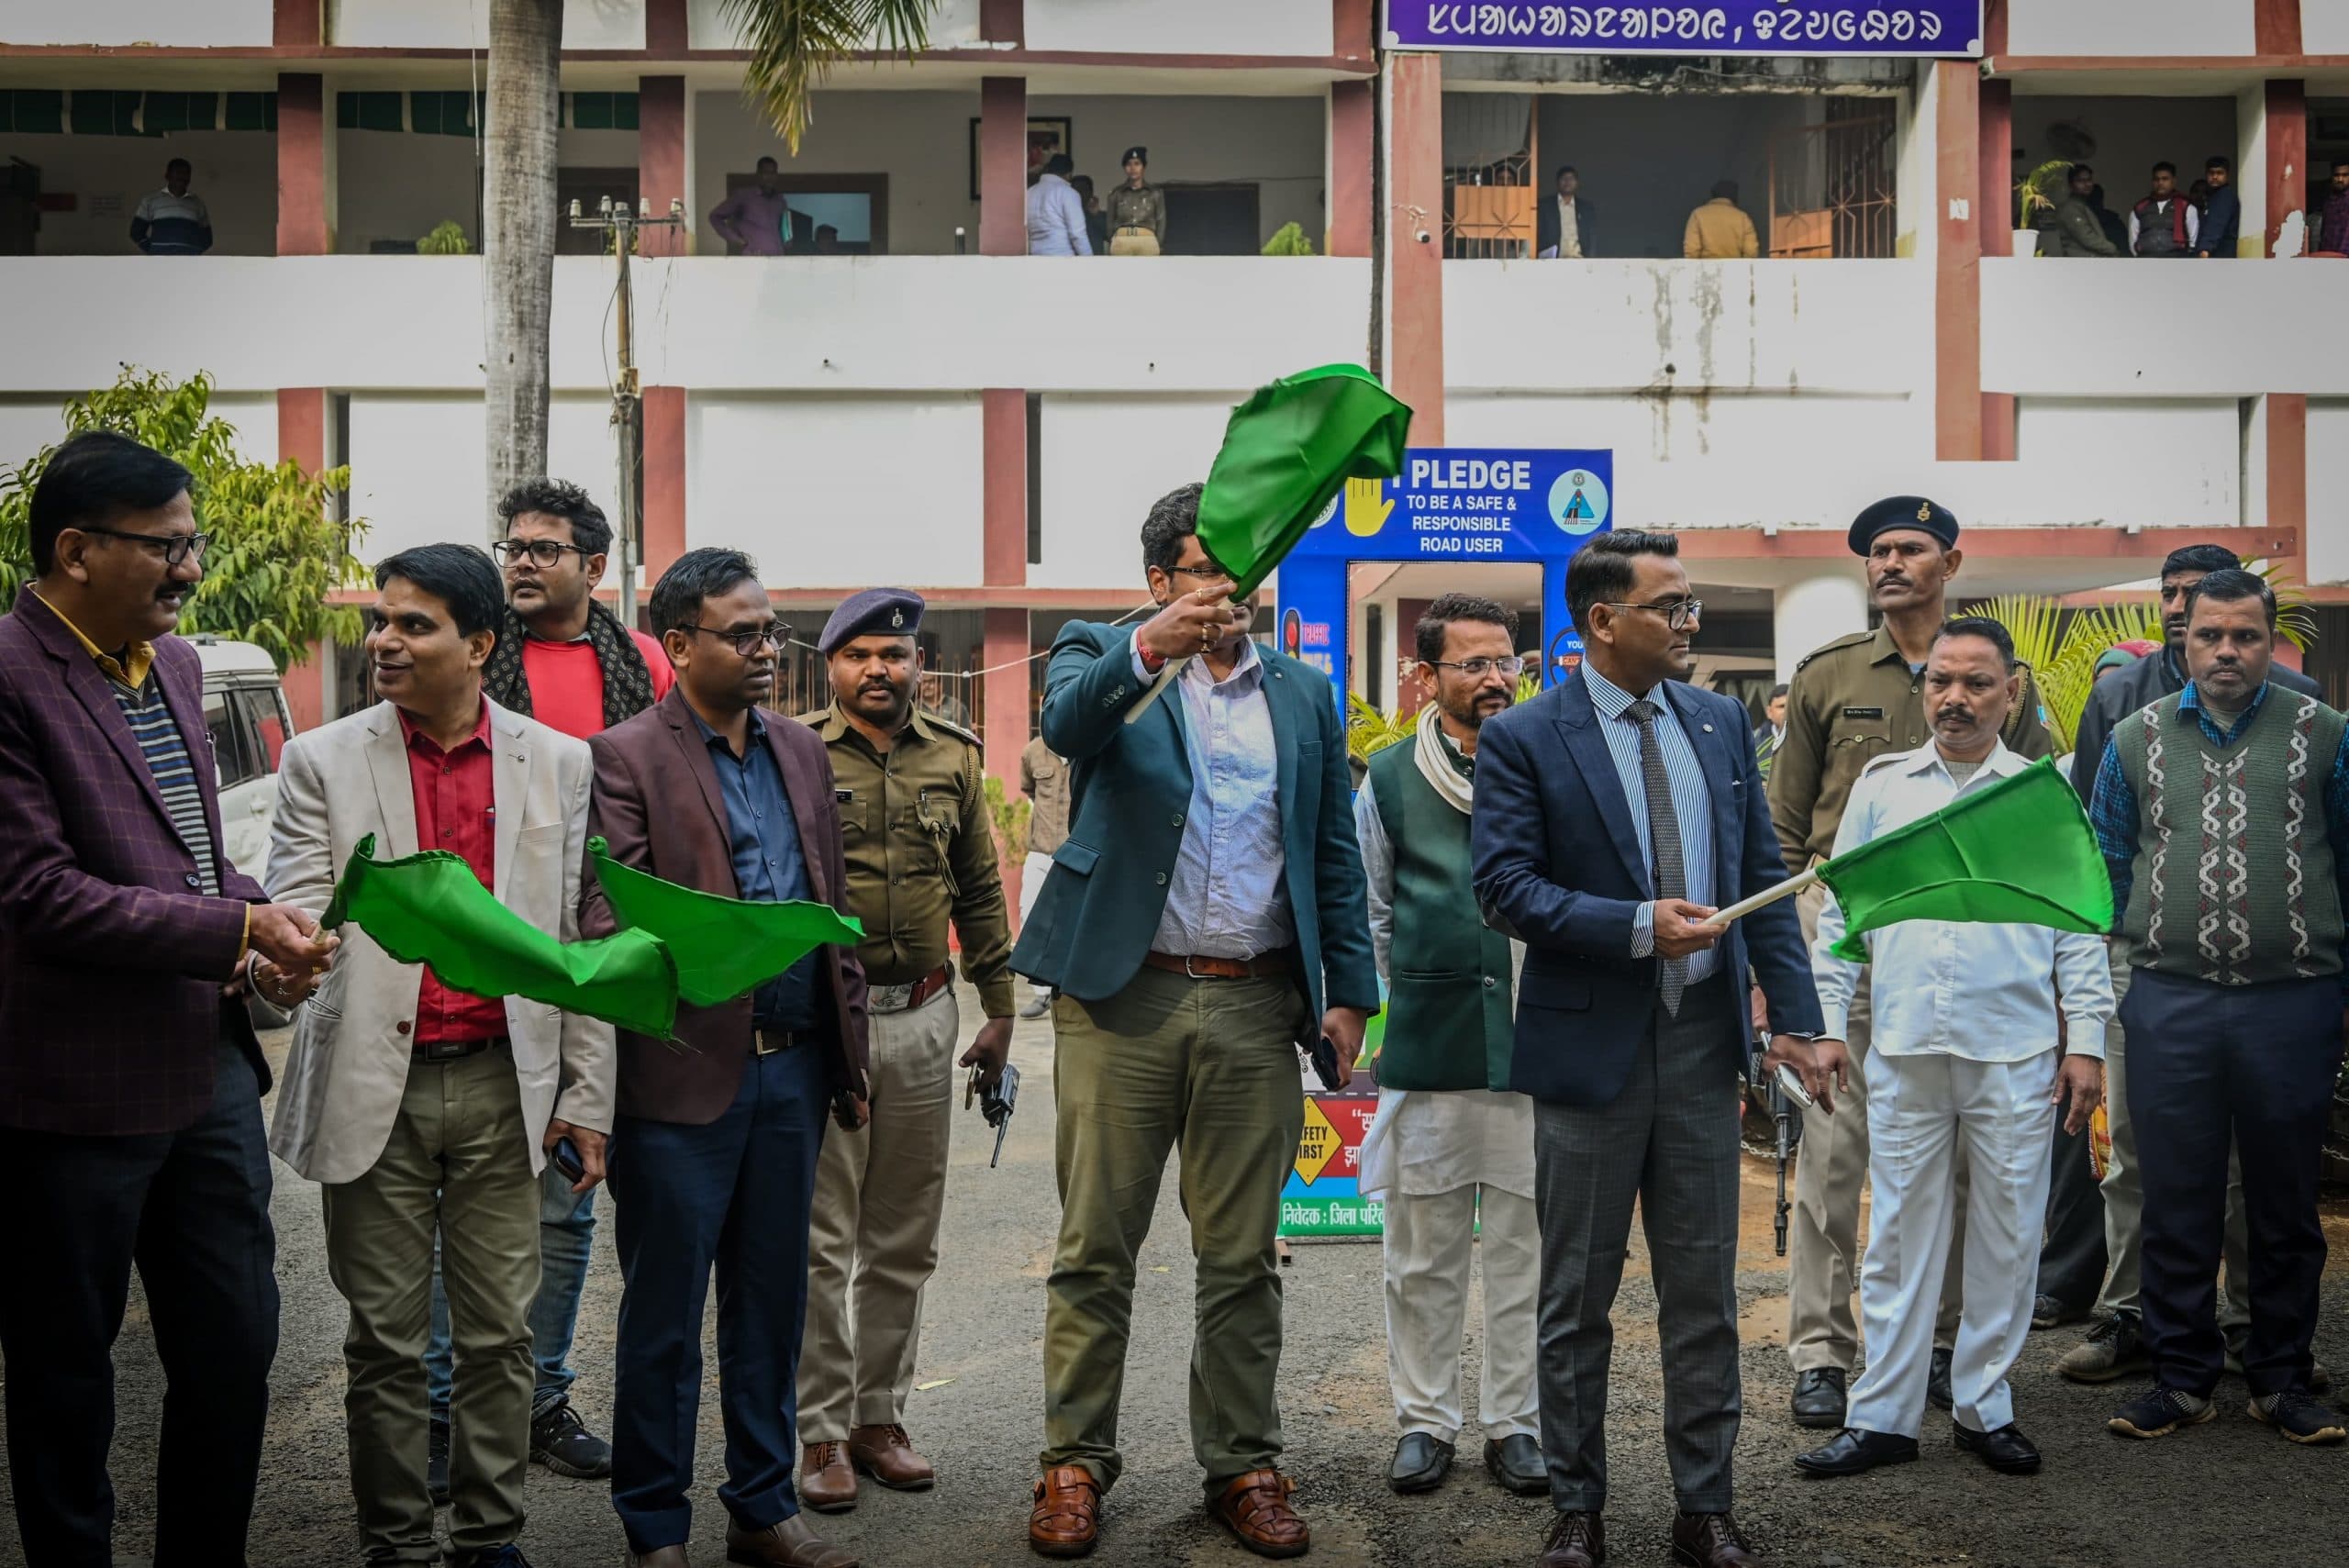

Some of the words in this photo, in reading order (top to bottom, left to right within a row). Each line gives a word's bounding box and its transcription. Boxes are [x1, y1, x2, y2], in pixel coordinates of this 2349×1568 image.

[1411, 460, 1531, 490] PLEDGE
[1406, 495, 1424, 509] TO
[1430, 495, 1449, 509] BE
[1453, 495, 1463, 510] A
[1466, 495, 1503, 511] SAFE
[1507, 496, 1517, 511] &
[1413, 516, 1511, 531] RESPONSIBLE
[1420, 538, 1461, 551] ROAD
[1464, 538, 1503, 552] USER
[1303, 624, 1330, 645] TRAFFIC
[1301, 1126, 1328, 1140] FETY
[1298, 1144, 1323, 1159] IRST
[1283, 1202, 1321, 1226] निवेदक
[1330, 1202, 1357, 1225] जिला
